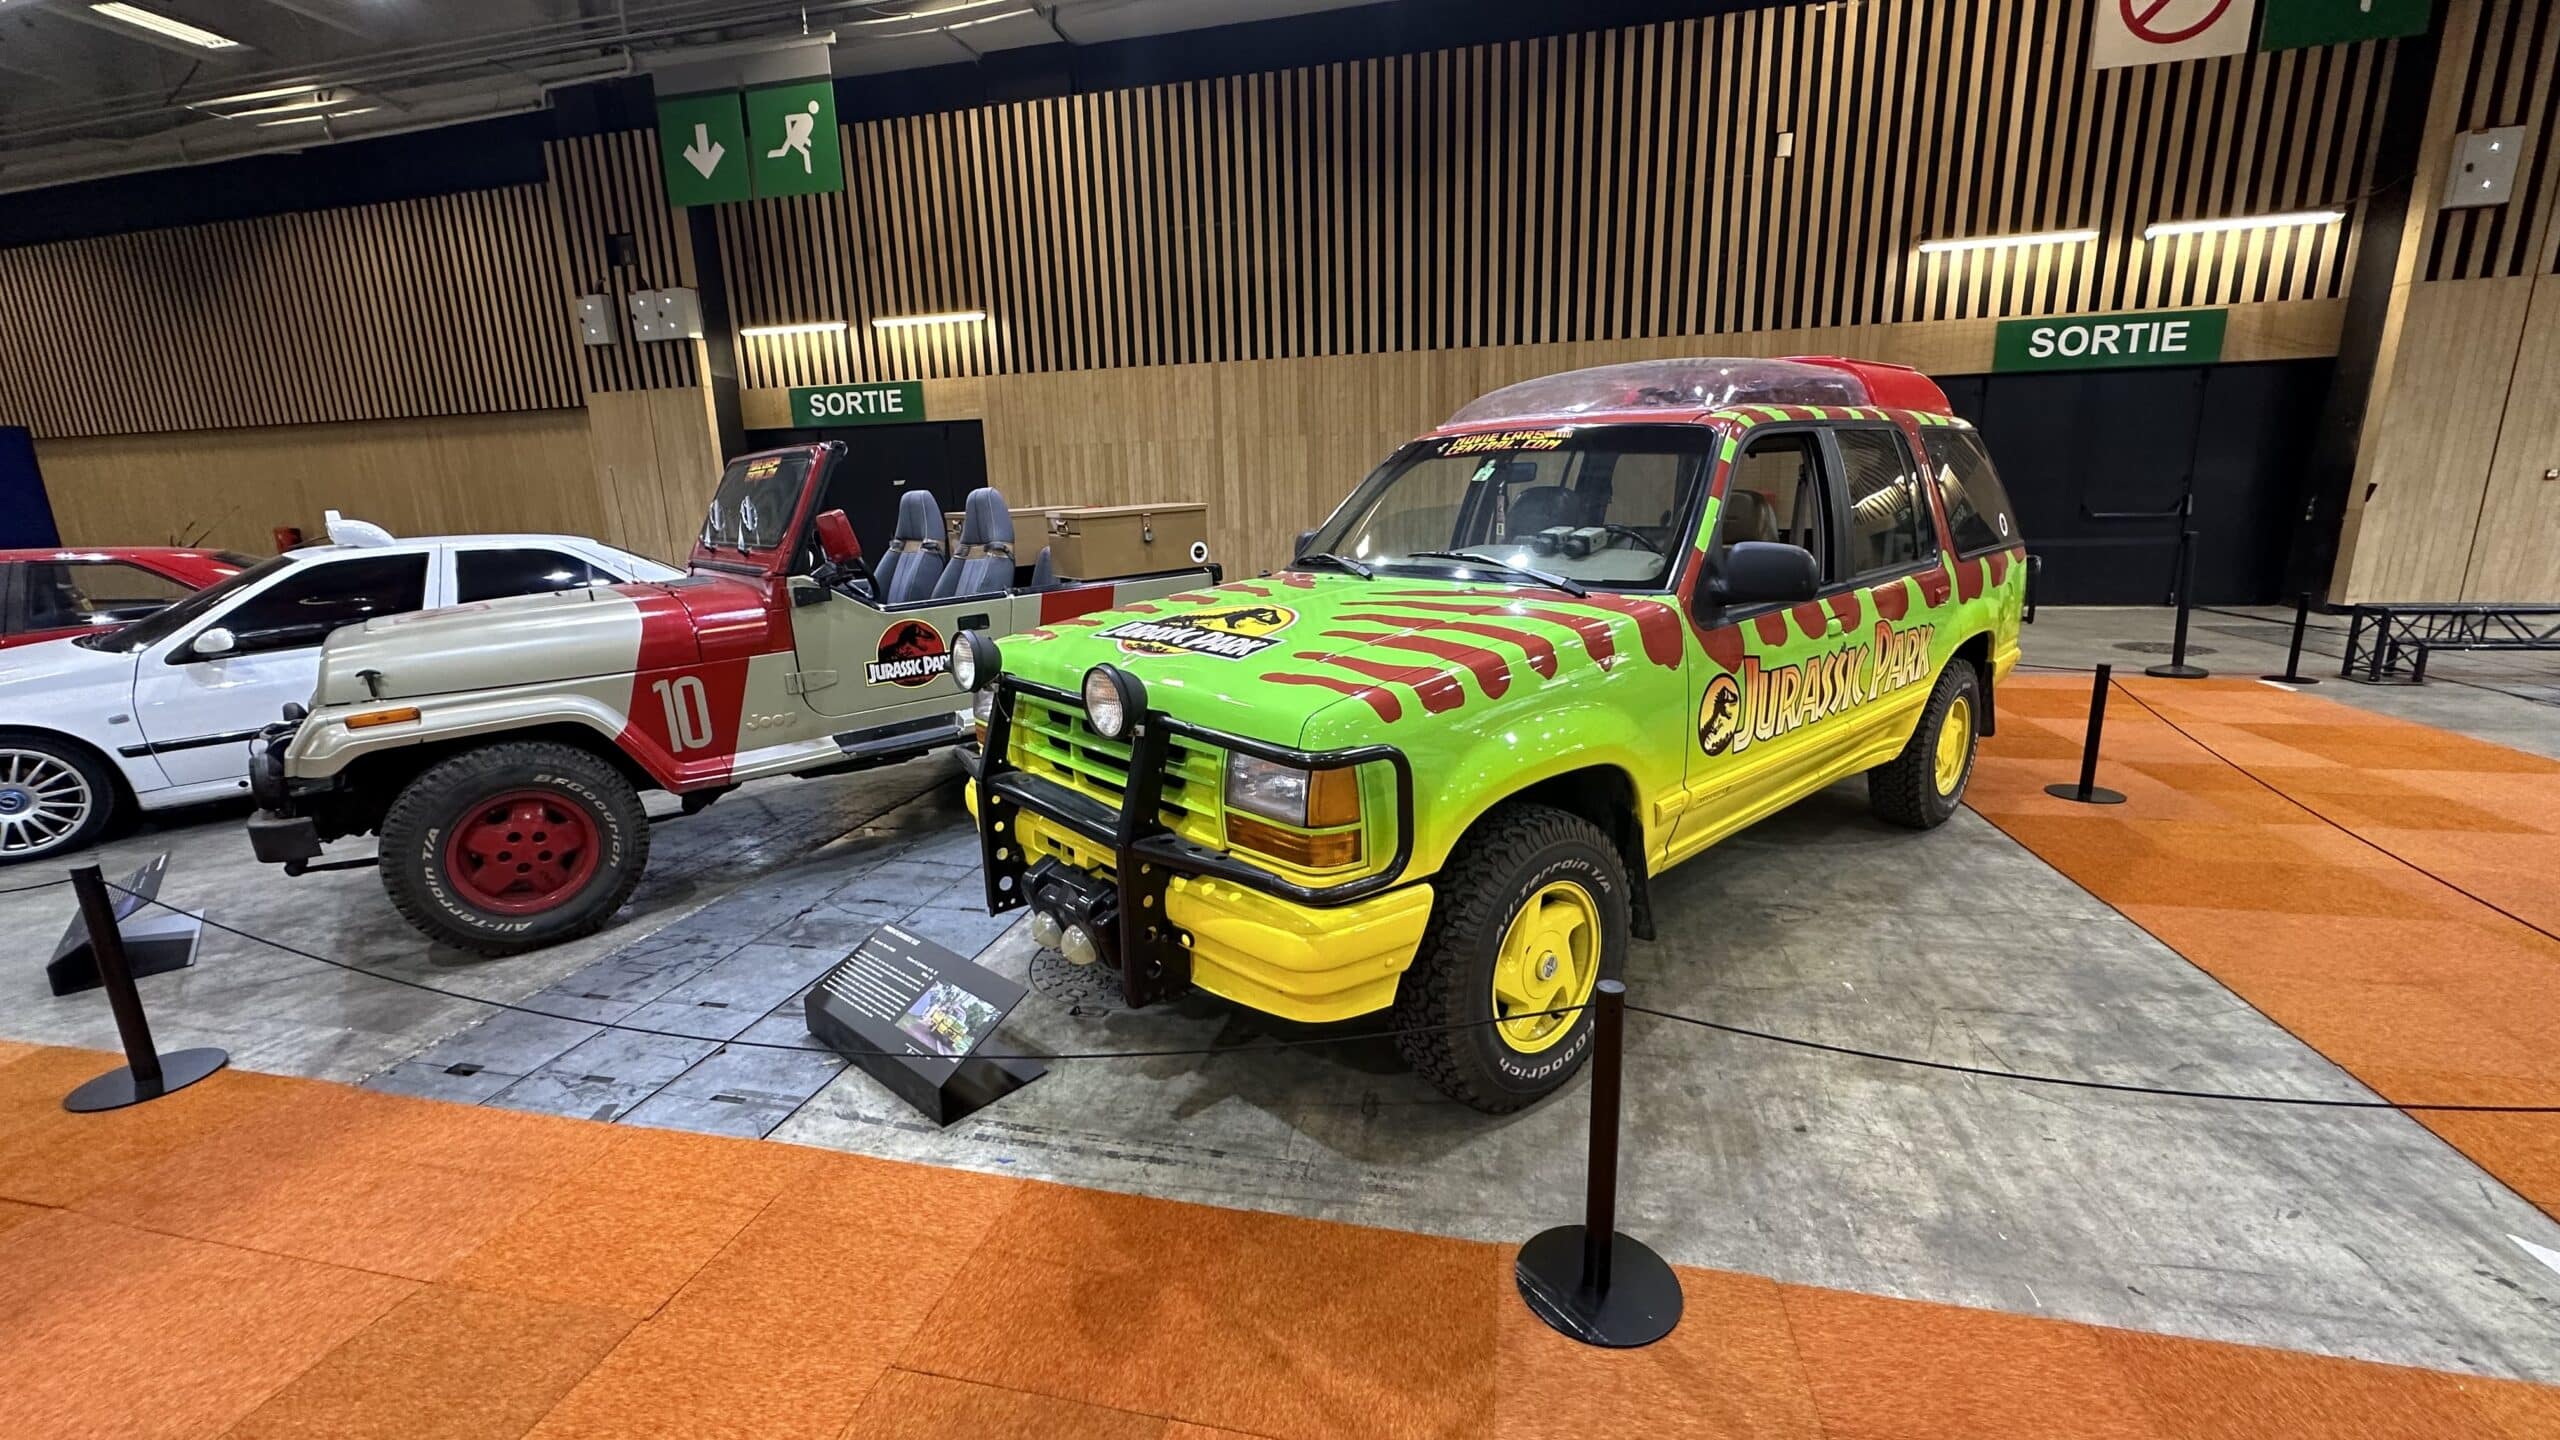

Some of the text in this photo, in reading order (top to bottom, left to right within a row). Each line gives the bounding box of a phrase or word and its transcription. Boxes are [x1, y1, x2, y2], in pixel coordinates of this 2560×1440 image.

[2028, 320, 2190, 359] SORTIE
[809, 389, 904, 417] SORTIE
[1452, 430, 1545, 447] MOVIE CARS
[1100, 622, 1269, 656] JURASSIC PARK
[868, 658, 923, 684] JURASSIC
[1731, 619, 1935, 754] JURASSIC PARK
[652, 675, 713, 753] 10
[532, 774, 622, 868] BFGoodrich
[422, 827, 534, 932] All-Terrain T/A
